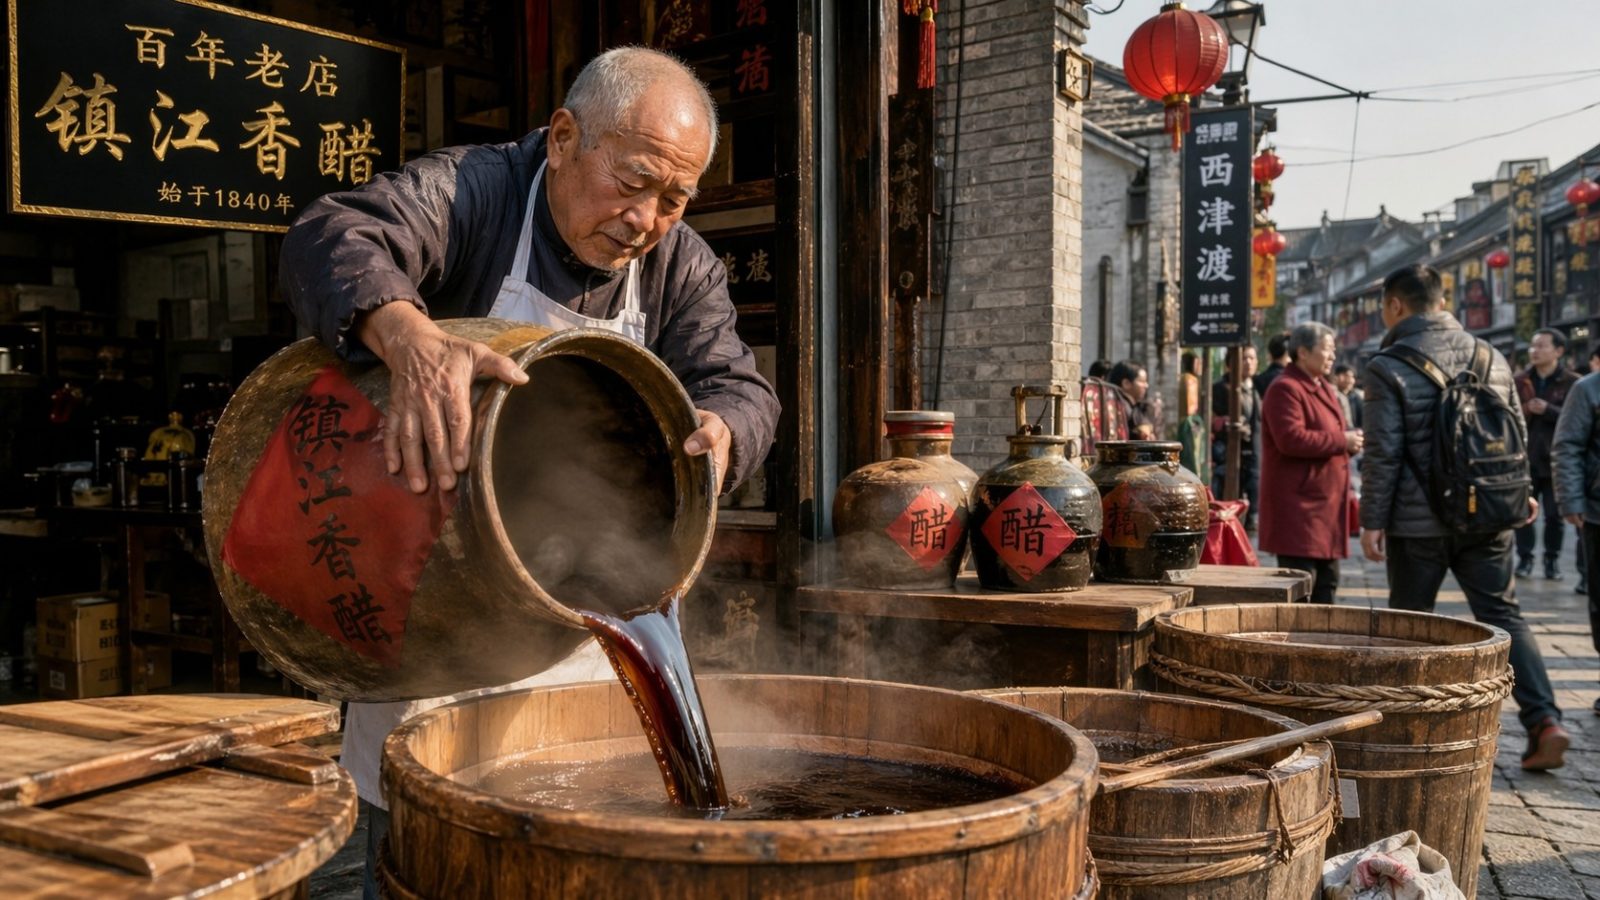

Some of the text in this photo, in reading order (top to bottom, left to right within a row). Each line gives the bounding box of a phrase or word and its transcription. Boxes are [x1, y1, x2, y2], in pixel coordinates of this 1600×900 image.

[125, 24, 338, 97] 百年老店
[35, 72, 382, 184] 镇江香醋
[157, 181, 295, 215] 始于1840年
[1197, 153, 1236, 283] 西津渡
[289, 395, 392, 644] 镇江香醋
[909, 503, 951, 550] 醋
[1000, 502, 1053, 557] 醋
